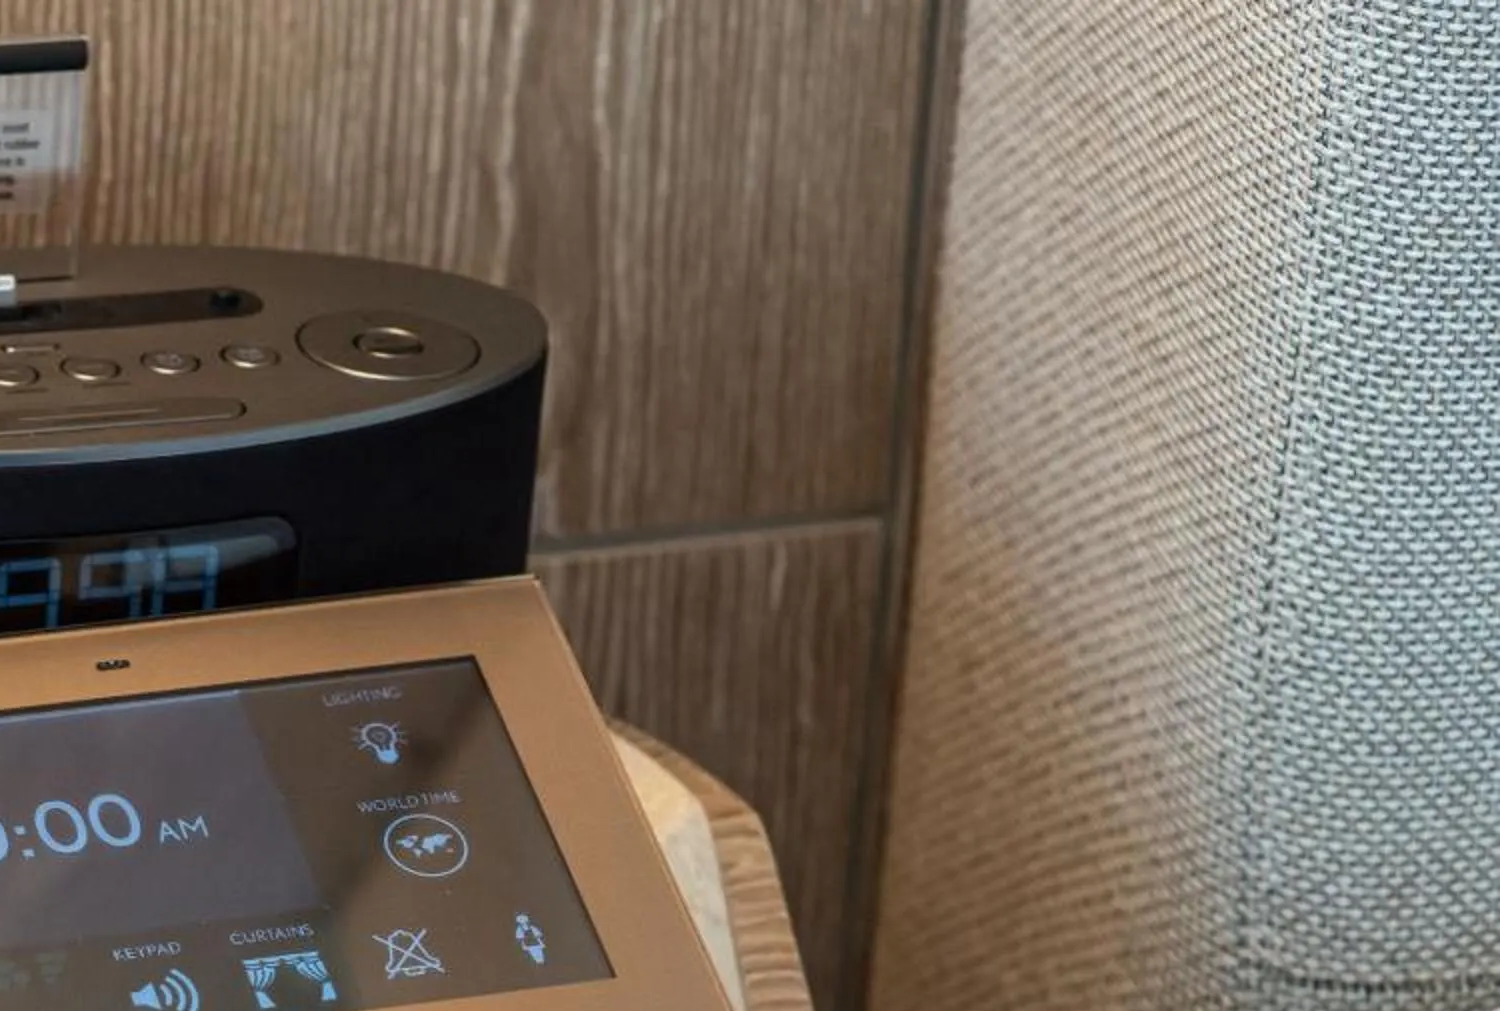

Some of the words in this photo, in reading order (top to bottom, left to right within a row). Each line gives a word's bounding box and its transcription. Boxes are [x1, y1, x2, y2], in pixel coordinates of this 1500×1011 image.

[321, 685, 403, 708] LIGHTING
[356, 795, 419, 814] WORLD
[419, 790, 461, 806] TIME
[158, 815, 209, 844] AM
[229, 922, 315, 946] CURTAINS
[111, 941, 182, 962] KEYPAD
